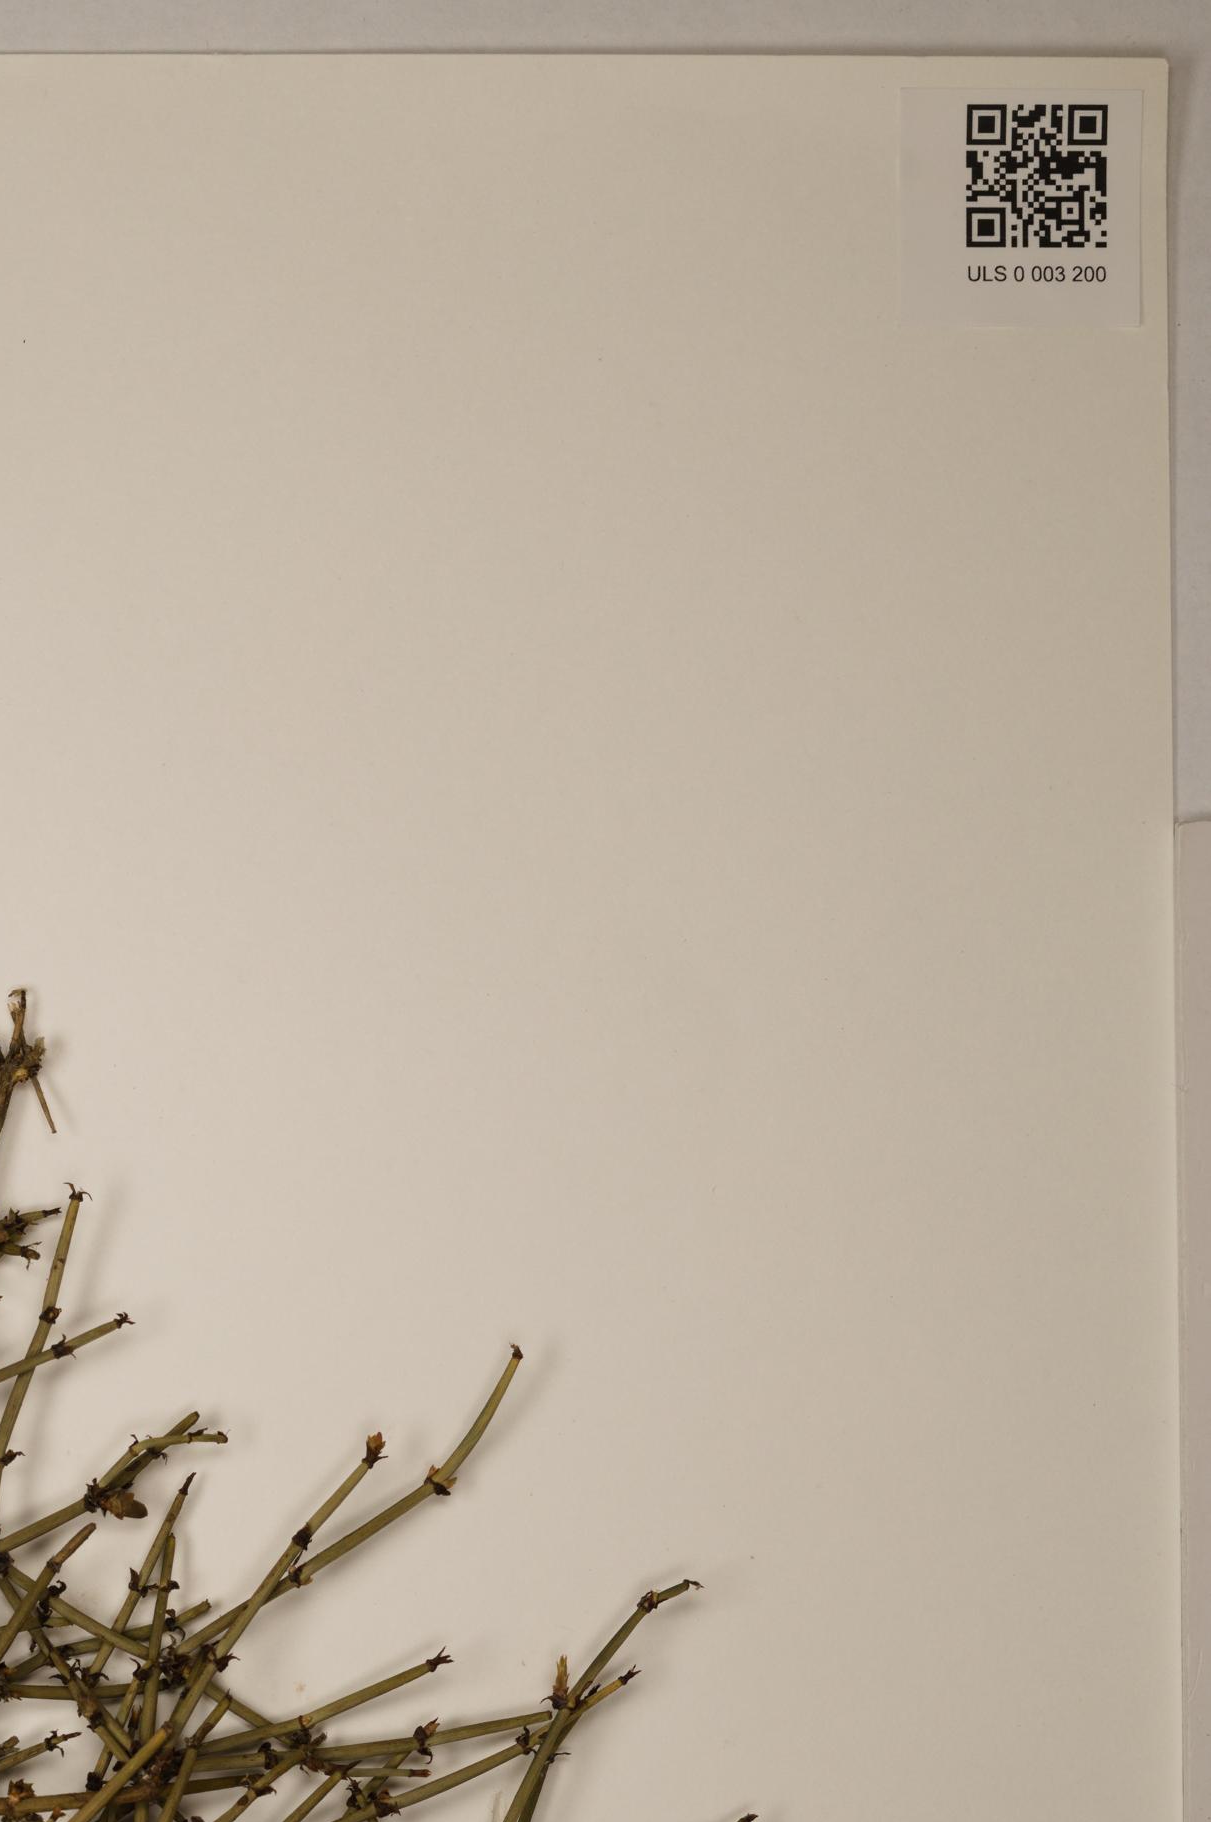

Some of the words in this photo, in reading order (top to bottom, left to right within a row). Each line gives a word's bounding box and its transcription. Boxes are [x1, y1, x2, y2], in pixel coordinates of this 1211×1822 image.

[967, 265, 1007, 282] ULS
[1014, 265, 1025, 282] 0
[1031, 265, 1066, 282] 003
[1072, 265, 1107, 282] 200
